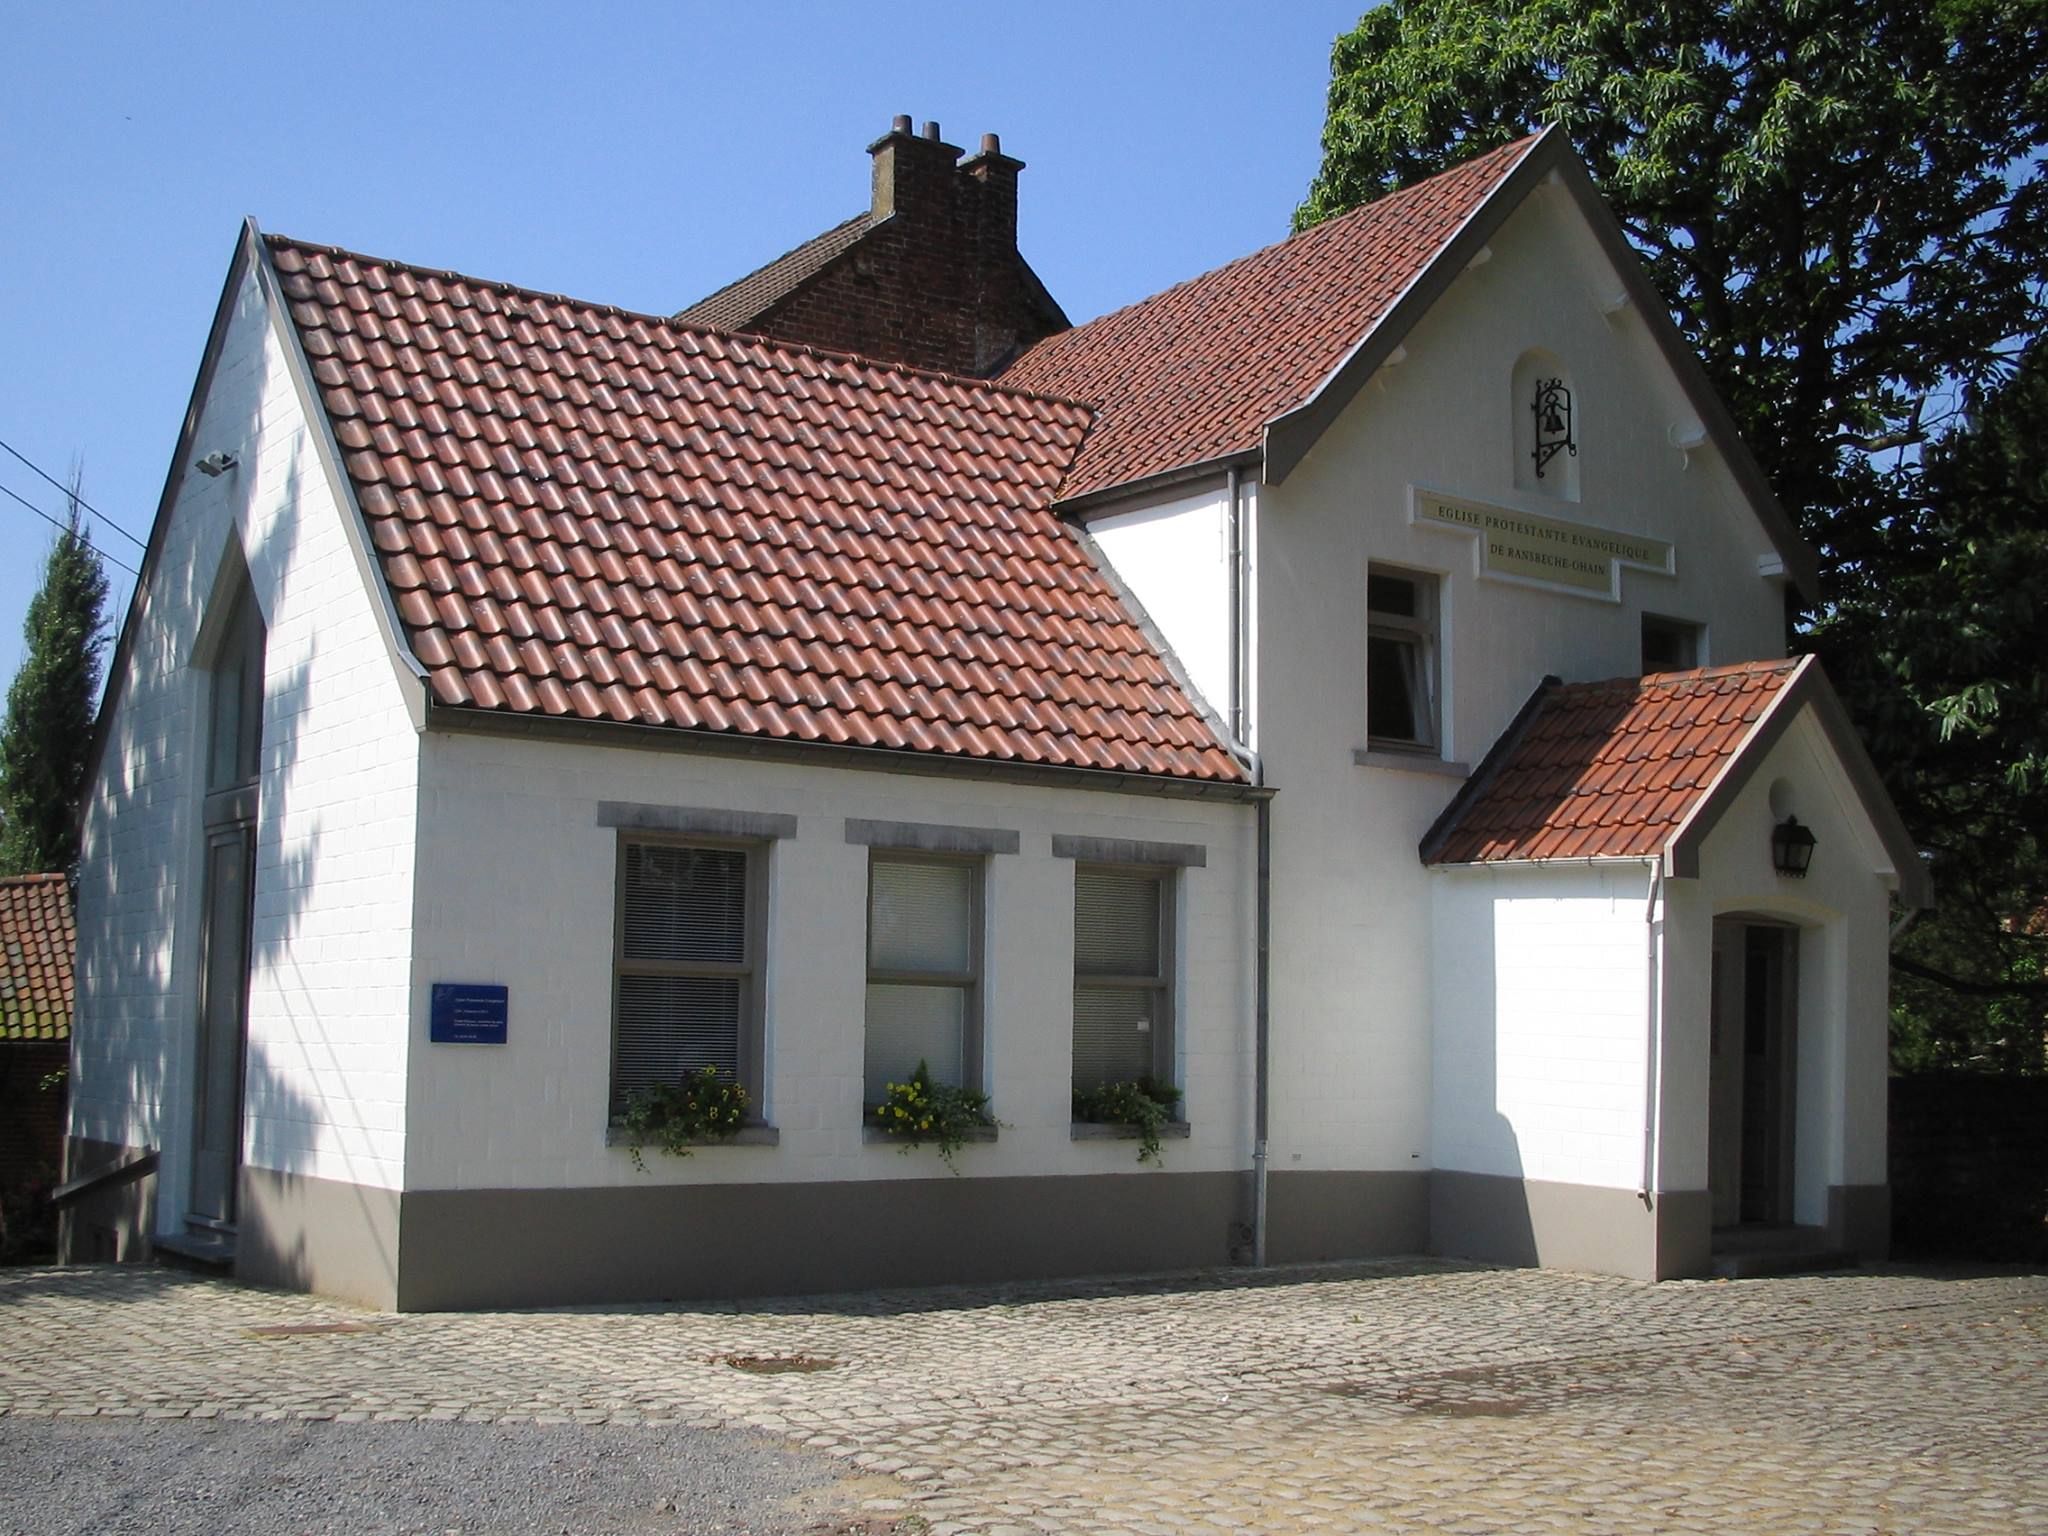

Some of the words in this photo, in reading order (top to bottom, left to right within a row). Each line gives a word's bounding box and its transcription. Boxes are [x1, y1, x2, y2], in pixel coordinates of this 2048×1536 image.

[1438, 505, 1481, 525] EGLISE
[1485, 515, 1569, 543] PROTESTANTE
[1571, 533, 1650, 560] EVANGELIQUE
[1490, 543, 1505, 556] DE
